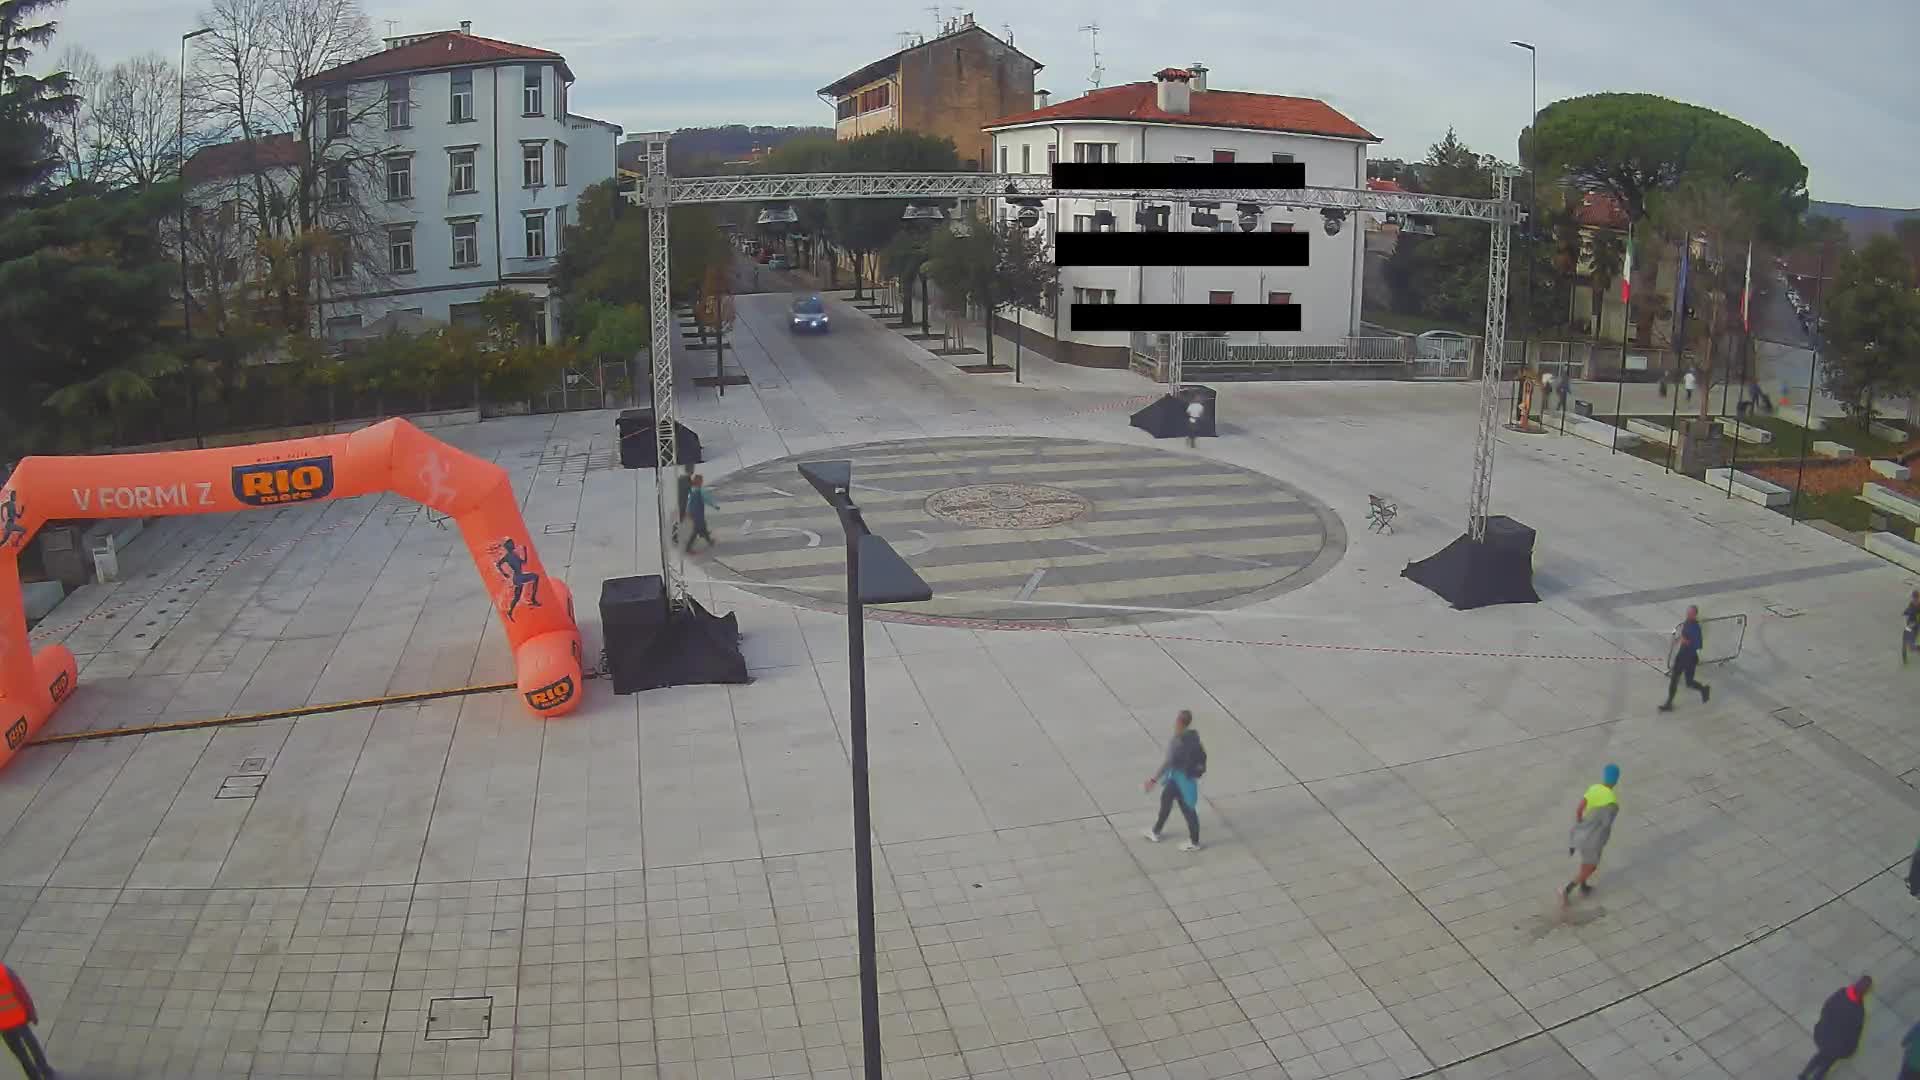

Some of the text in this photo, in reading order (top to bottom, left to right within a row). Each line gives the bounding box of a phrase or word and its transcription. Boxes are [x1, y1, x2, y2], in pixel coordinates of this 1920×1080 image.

[72, 481, 216, 511] V FORMI Z
[242, 466, 323, 497] RIO
[531, 682, 569, 704] RIO
